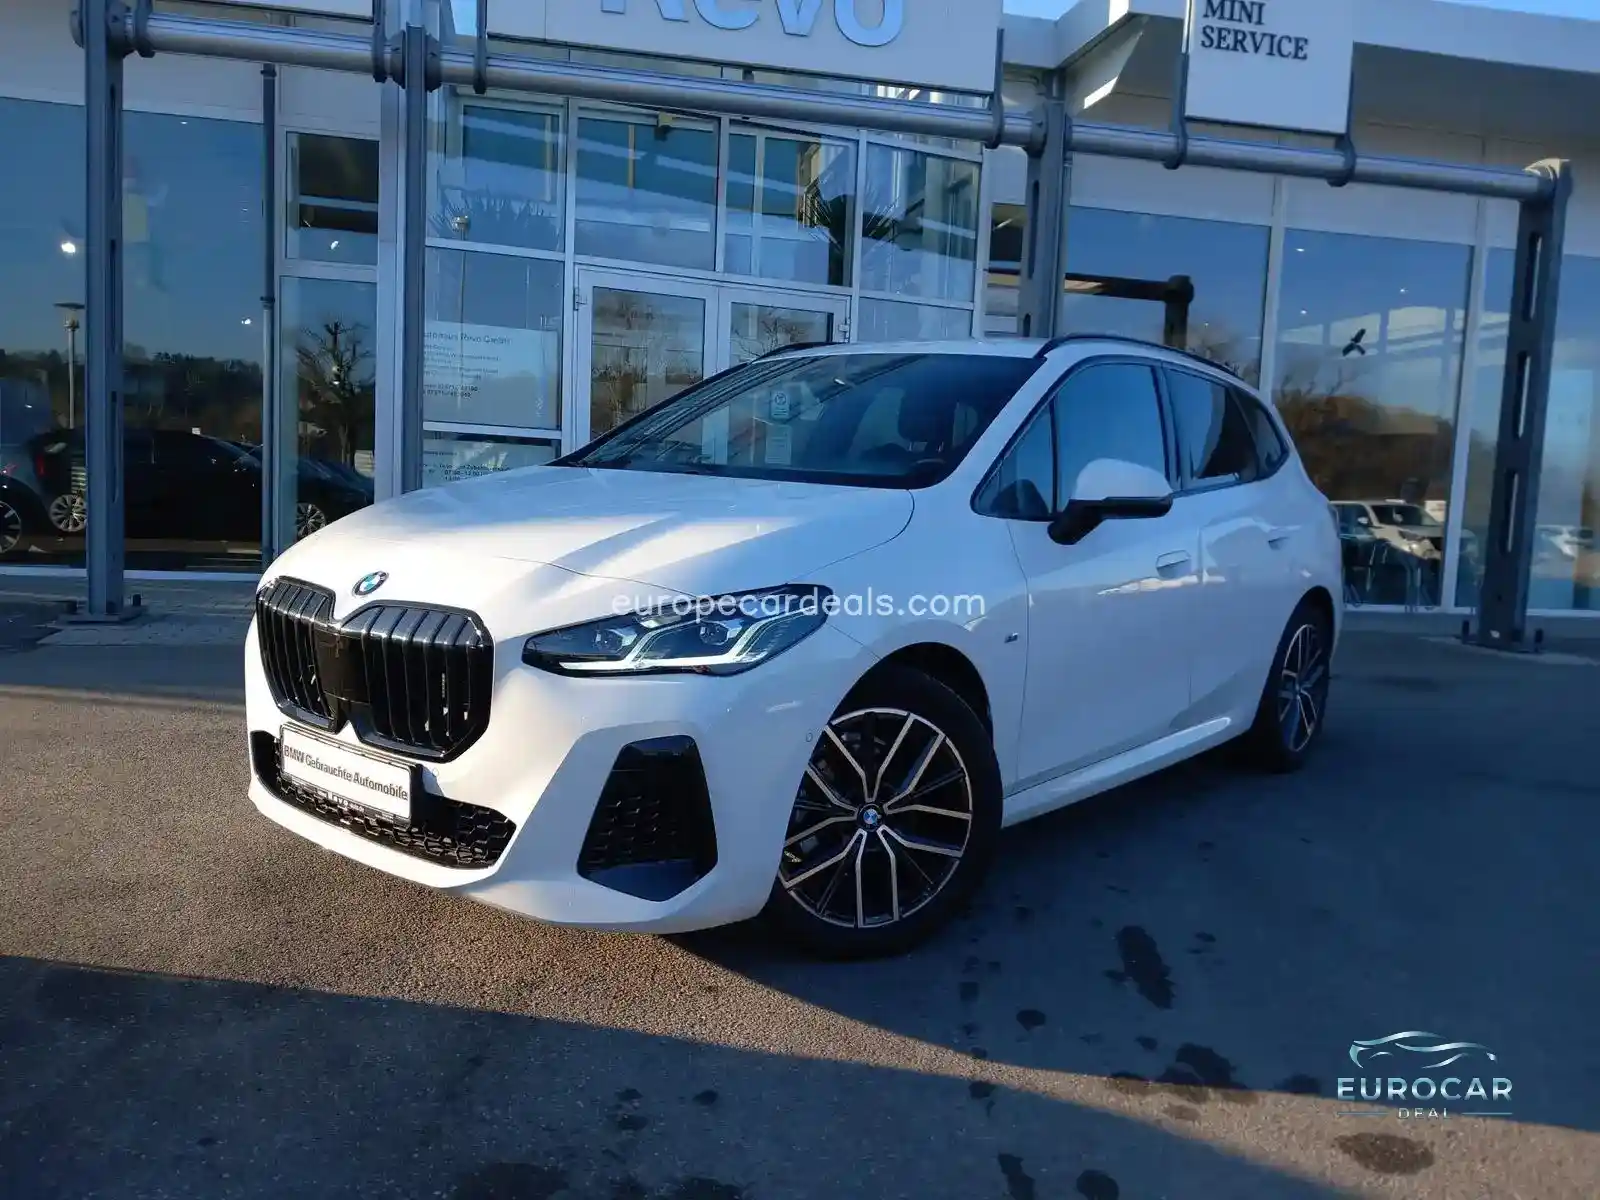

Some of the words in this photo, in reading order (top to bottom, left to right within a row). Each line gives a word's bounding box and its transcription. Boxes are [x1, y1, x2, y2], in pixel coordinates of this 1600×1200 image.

[600, 0, 907, 47] vo
[1203, 0, 1266, 26] MINI
[1201, 24, 1309, 61] SERVICE
[283, 744, 305, 764] BMW
[305, 754, 353, 782] Gebrauchte
[353, 771, 409, 801] Automobile
